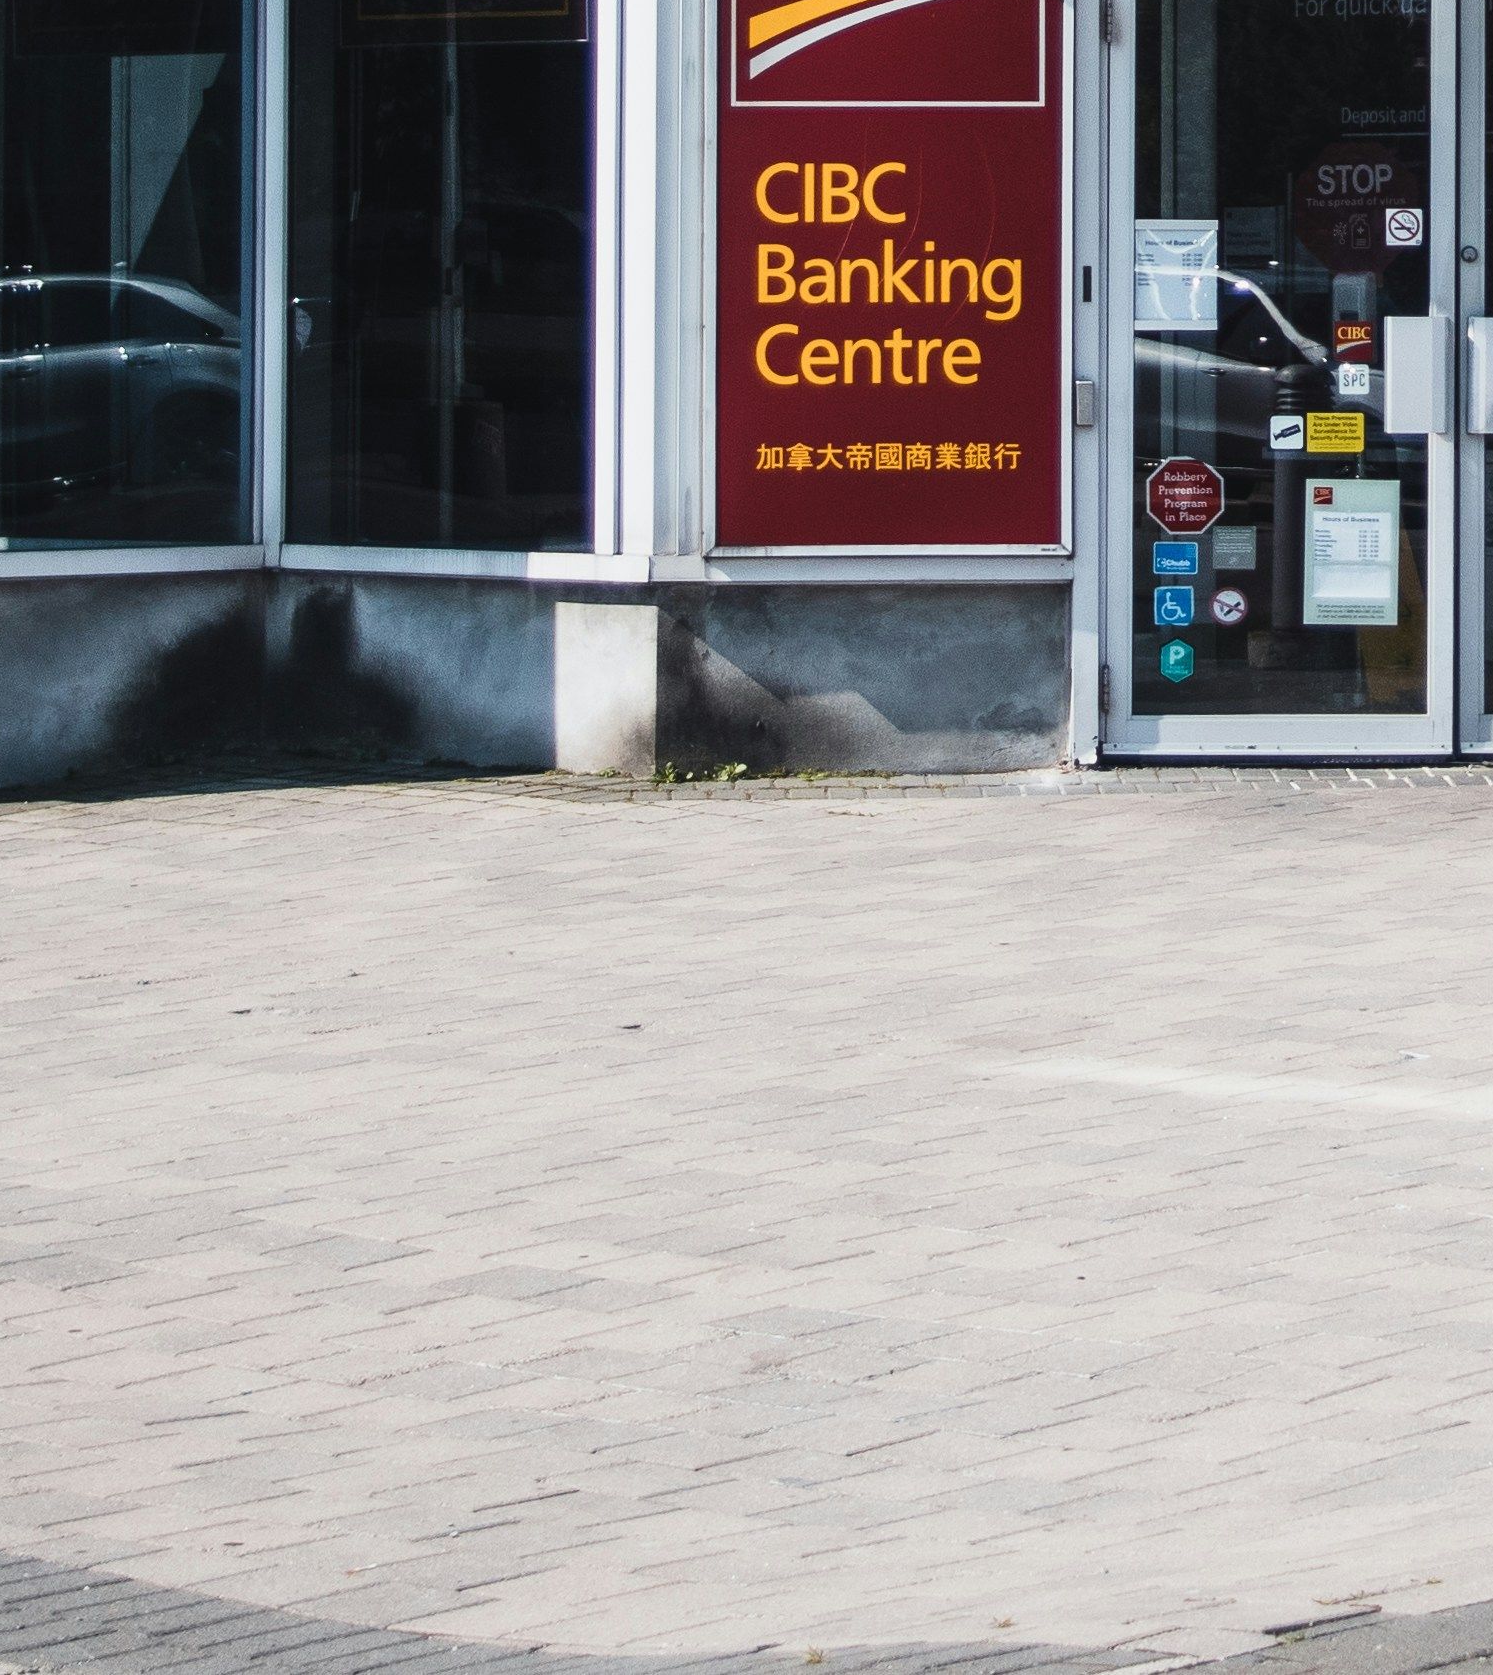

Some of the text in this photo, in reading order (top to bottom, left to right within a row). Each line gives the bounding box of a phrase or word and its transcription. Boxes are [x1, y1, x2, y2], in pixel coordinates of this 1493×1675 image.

[1317, 163, 1393, 195] STOP
[755, 162, 906, 226] CIBC
[1306, 197, 1325, 207] The
[1327, 197, 1364, 208] spread
[757, 239, 1023, 321] Banking
[1337, 326, 1372, 340] CIBC
[755, 324, 982, 386] Centre
[1343, 373, 1366, 387] SPC
[755, 441, 1022, 472] 加拿大帝國商業銀行
[1163, 472, 1208, 483] Robbery
[1158, 484, 1213, 496] Prevention
[1164, 498, 1208, 510] Program
[1165, 511, 1207, 522] in Place
